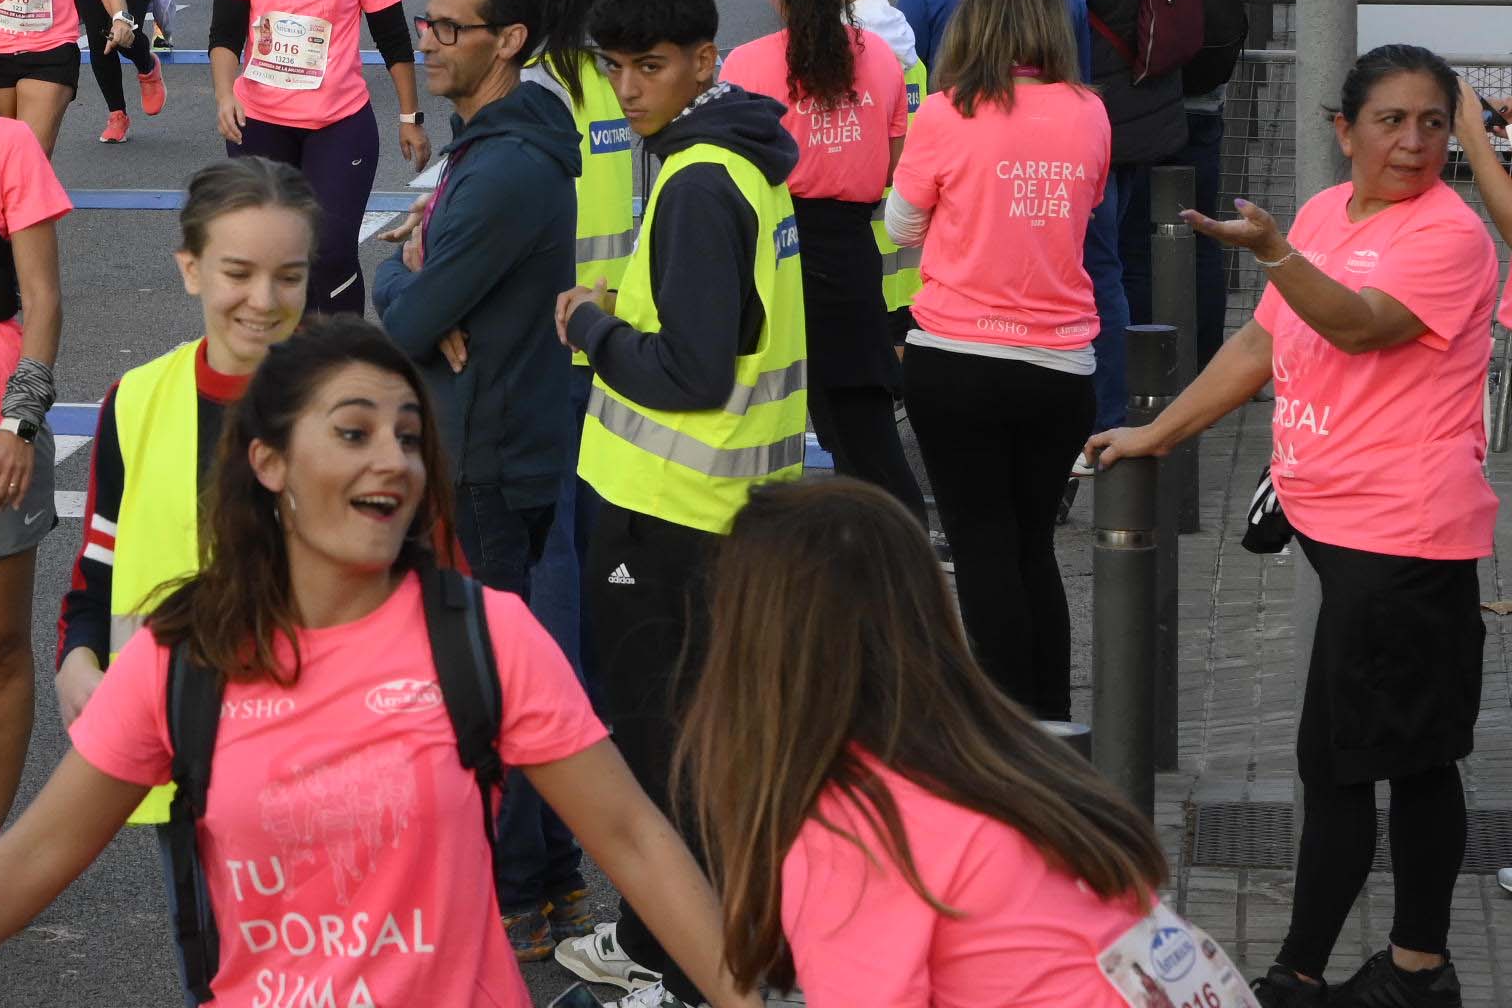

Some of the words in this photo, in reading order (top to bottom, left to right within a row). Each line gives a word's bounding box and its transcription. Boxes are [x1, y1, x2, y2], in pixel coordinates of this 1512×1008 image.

[274, 41, 300, 55] 016
[275, 55, 295, 65] 13236
[811, 111, 832, 130] DE
[838, 109, 859, 127] LA
[808, 126, 862, 148] MUJER
[996, 160, 1086, 181] CARRERA
[1013, 180, 1038, 198] DE
[1044, 180, 1069, 199] LA
[1009, 199, 1072, 219] MUJER
[976, 318, 1028, 337] OYSHO
[608, 575, 635, 584] adidas
[226, 854, 285, 902] TU
[239, 908, 436, 958] DORSAL
[251, 968, 377, 1008] SUMA
